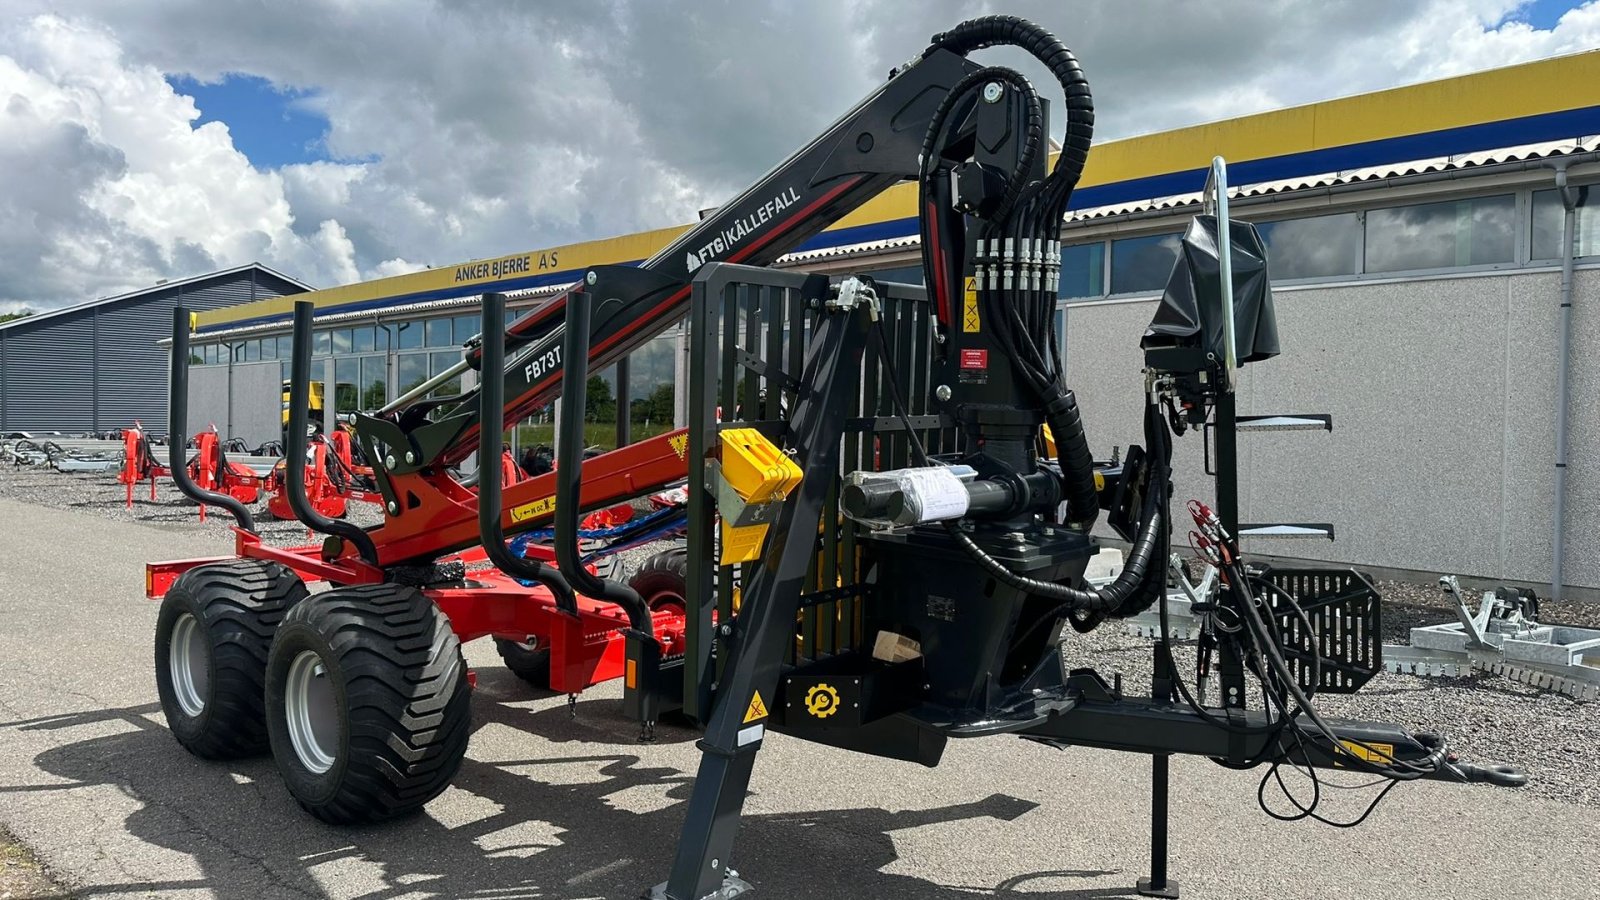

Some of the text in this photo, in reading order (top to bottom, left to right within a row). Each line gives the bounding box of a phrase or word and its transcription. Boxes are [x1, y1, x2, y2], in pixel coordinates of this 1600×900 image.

[698, 187, 800, 264] FTG KÄLLEFALL
[455, 252, 558, 282] ANKER BJERRE A/S
[525, 345, 561, 383] FB73T
